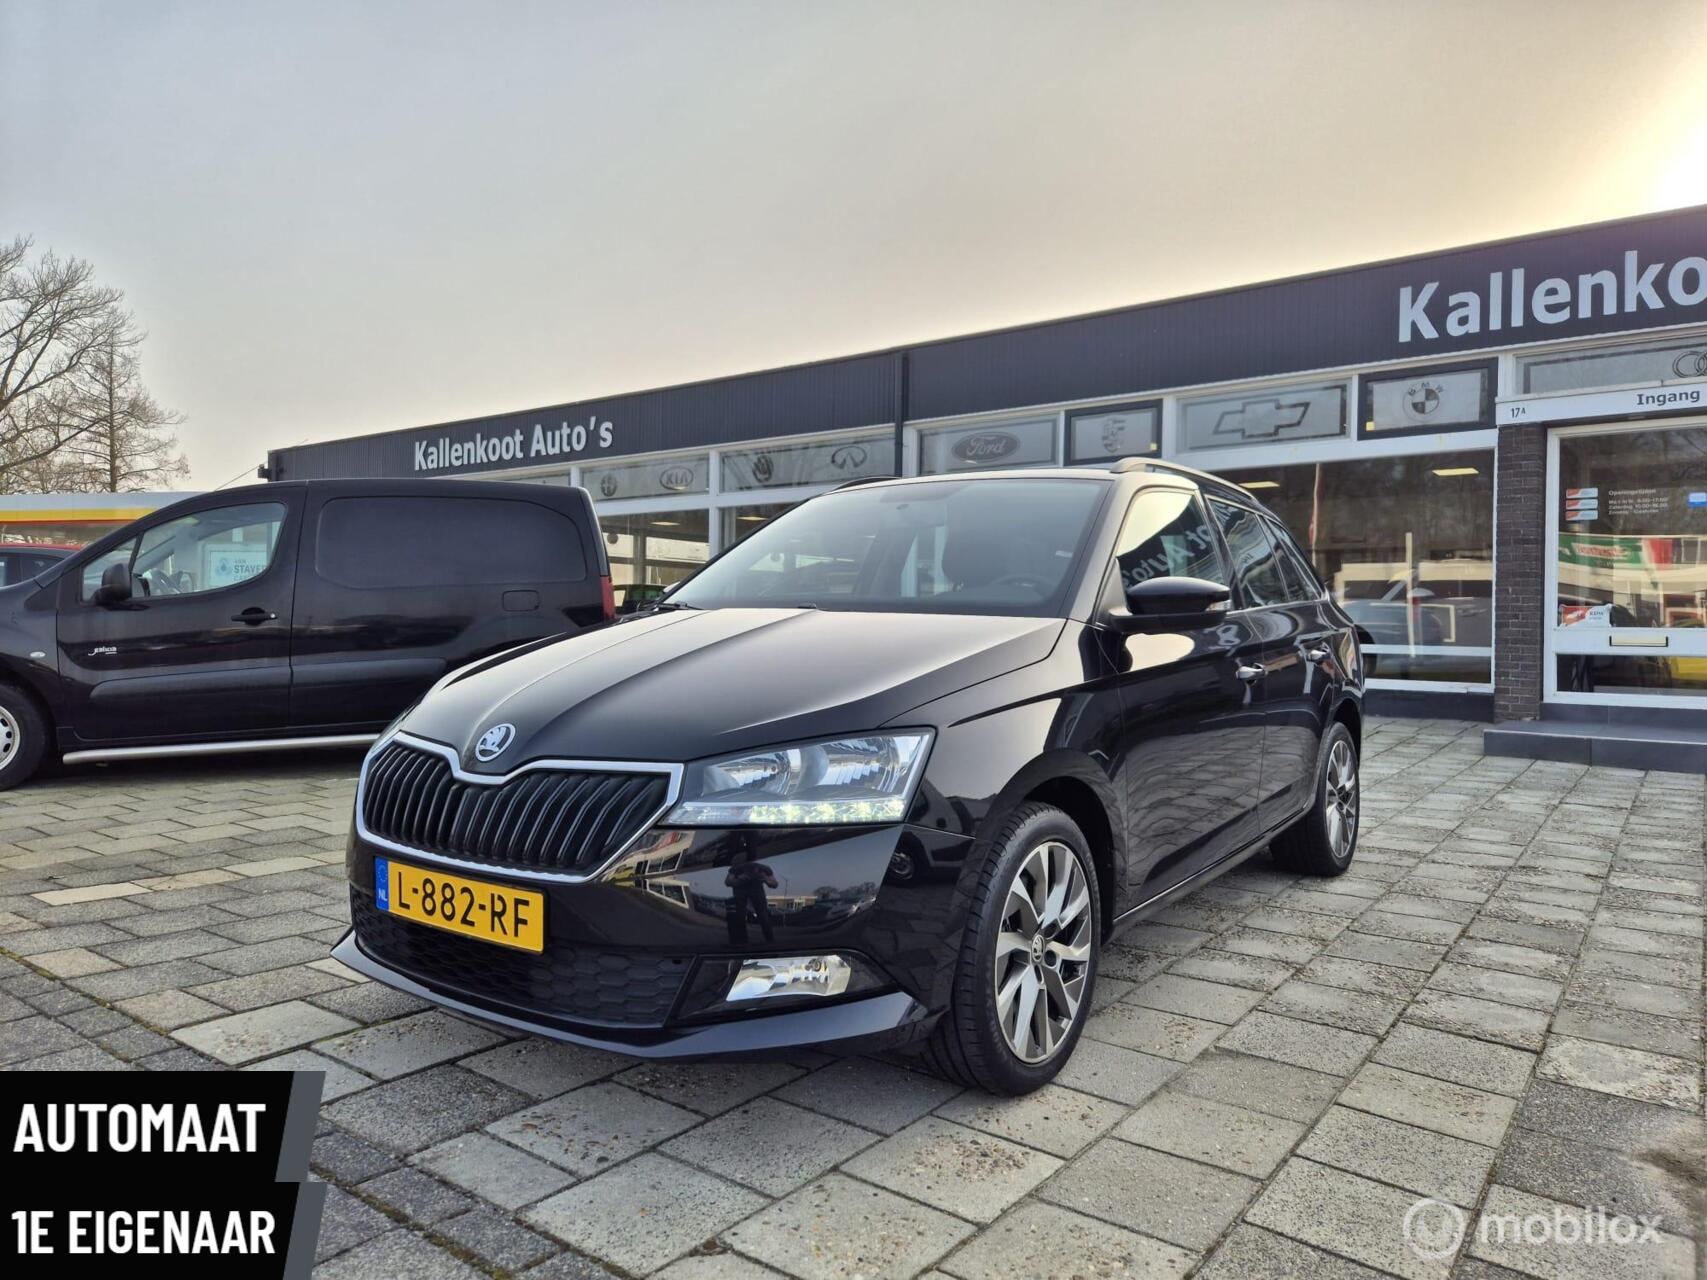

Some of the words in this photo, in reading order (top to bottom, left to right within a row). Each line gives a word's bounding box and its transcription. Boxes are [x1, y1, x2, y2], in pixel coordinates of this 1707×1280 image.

[1398, 250, 1707, 343] Kallenko
[1636, 390, 1700, 406] Ingang
[414, 428, 524, 471] Kallenkoot
[530, 416, 613, 458] Auto's
[378, 889, 388, 901] NL
[398, 871, 530, 937] L-882-RF
